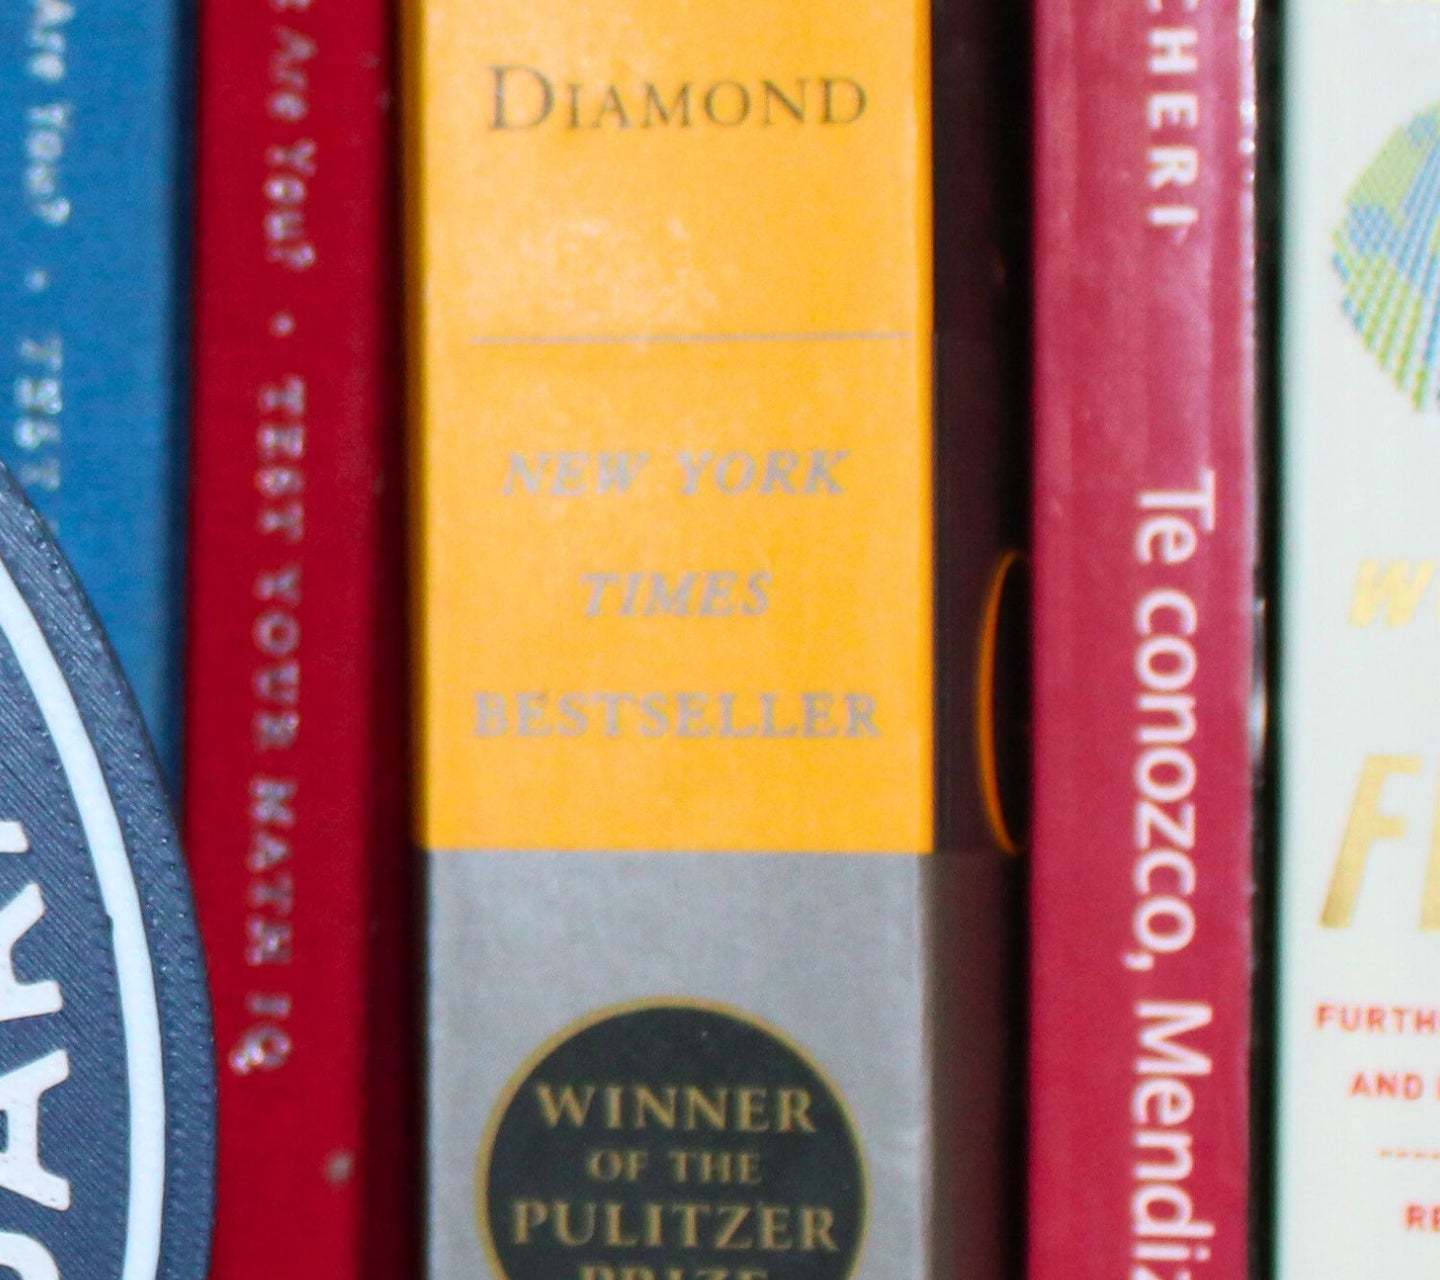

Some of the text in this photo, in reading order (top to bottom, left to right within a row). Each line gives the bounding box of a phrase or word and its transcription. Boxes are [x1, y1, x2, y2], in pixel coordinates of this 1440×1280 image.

[268, 25, 317, 120] Are
[502, 450, 851, 496] NEW YORK
[1134, 469, 1216, 565] Te
[579, 571, 772, 617] TIMES
[253, 567, 302, 750] YOUR
[473, 693, 882, 739] BESTSELLER
[1125, 588, 1198, 972] conozco,
[246, 779, 298, 965] MATH
[537, 1084, 816, 1133] WINNER
[1350, 1072, 1423, 1100] AND
[586, 1148, 762, 1184] OF THE
[512, 1199, 839, 1252] PULITZER
